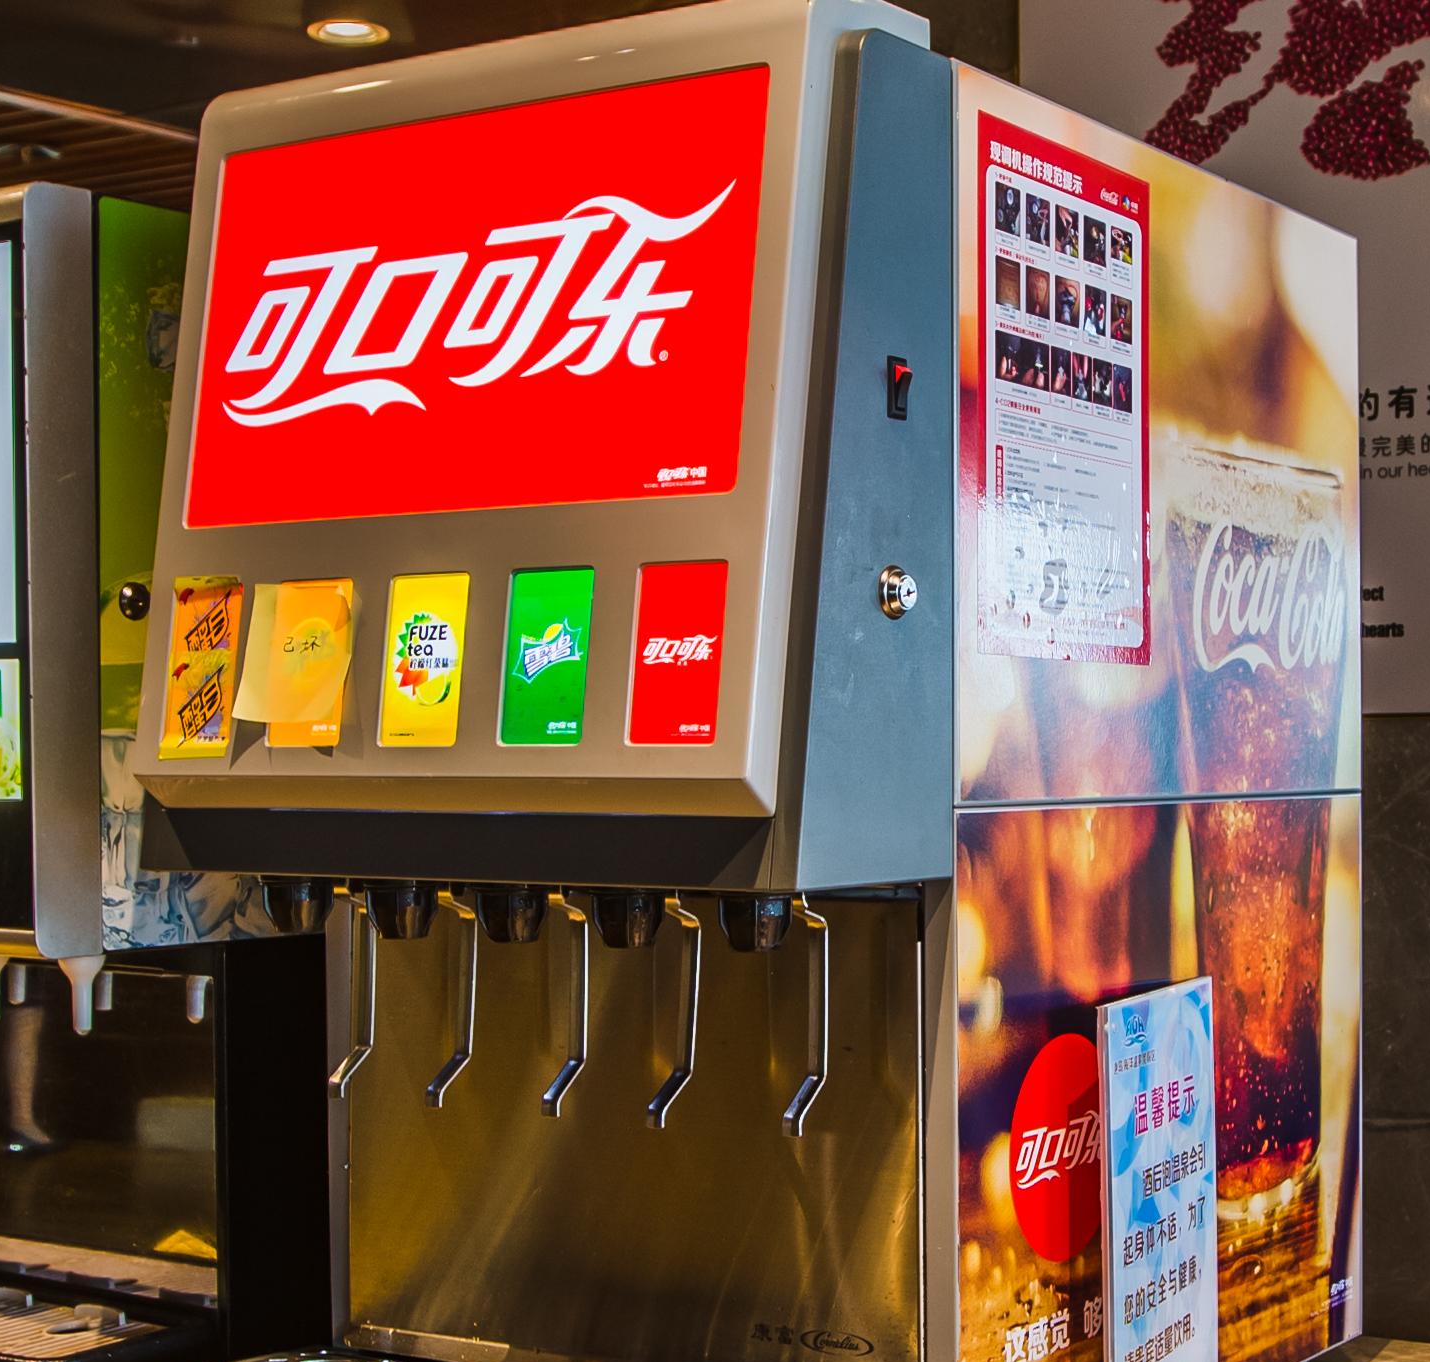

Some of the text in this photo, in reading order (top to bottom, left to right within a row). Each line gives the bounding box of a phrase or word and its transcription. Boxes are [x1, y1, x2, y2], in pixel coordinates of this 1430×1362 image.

[222, 178, 737, 427] 可口可乐
[1377, 464, 1402, 479] our
[1193, 519, 1346, 673] Coca-Cola
[407, 643, 433, 656] tea
[409, 625, 448, 641] FUZE
[523, 631, 573, 677] 雪碧
[642, 634, 718, 666] 可口可乐
[1134, 1075, 1196, 1137] 温馨提示
[1142, 1143, 1207, 1200] 酒后泡温泉会引
